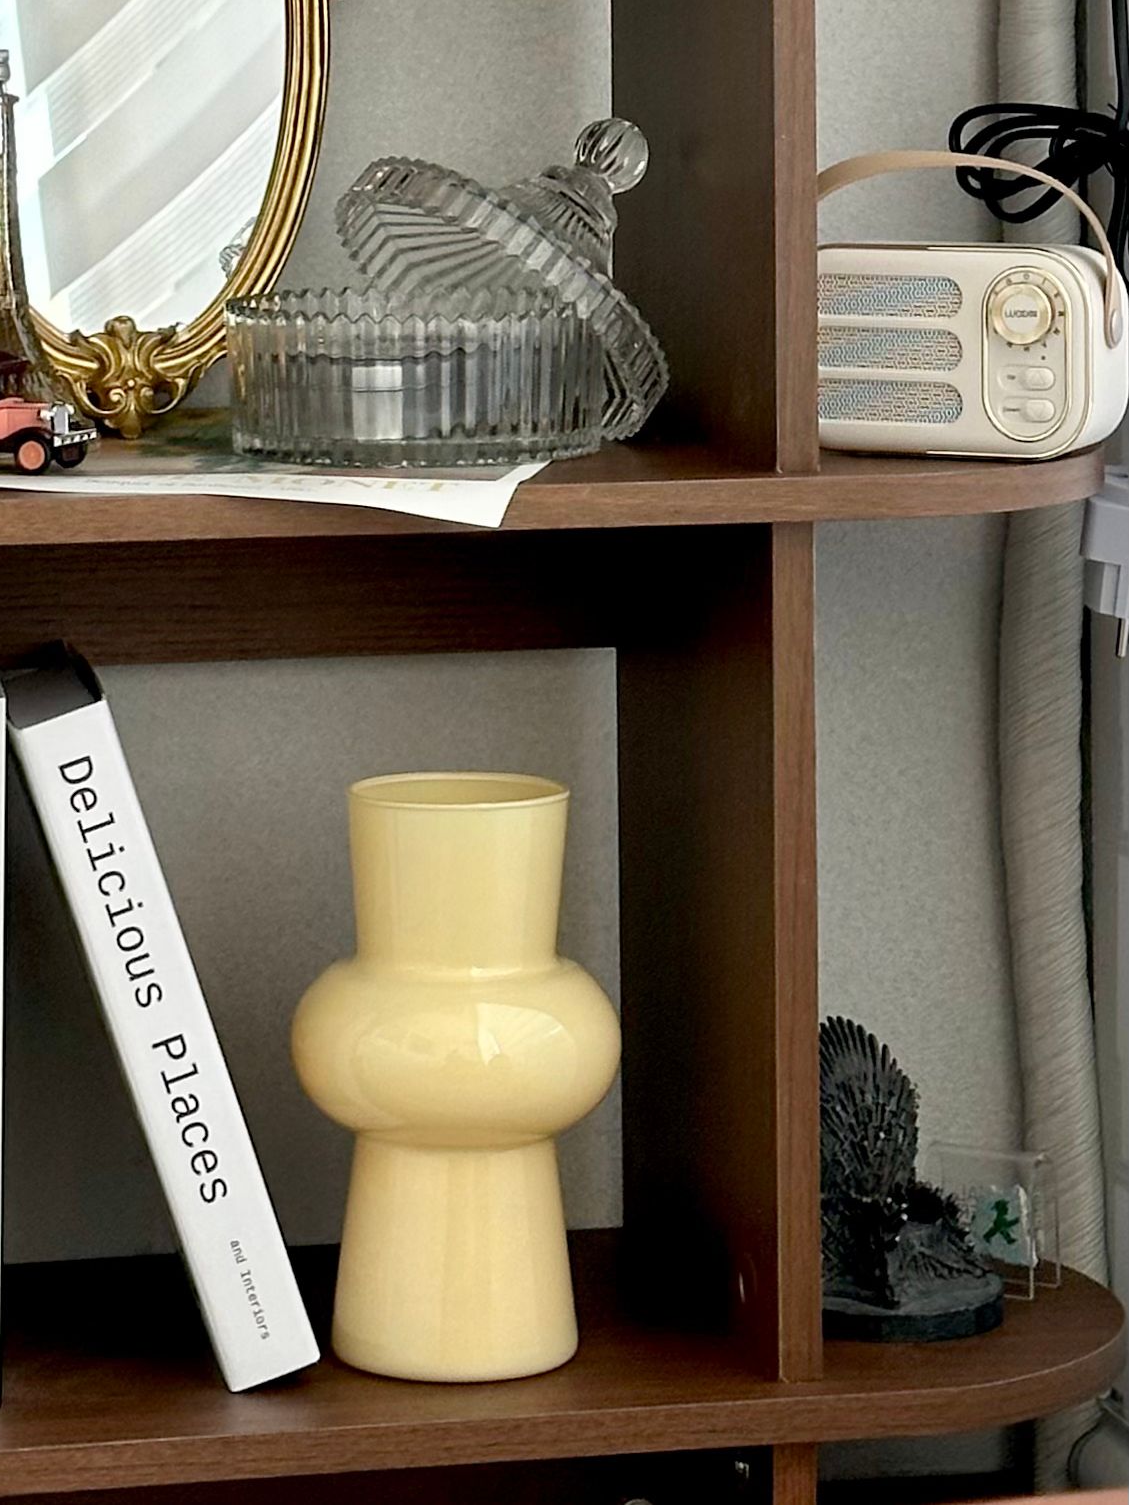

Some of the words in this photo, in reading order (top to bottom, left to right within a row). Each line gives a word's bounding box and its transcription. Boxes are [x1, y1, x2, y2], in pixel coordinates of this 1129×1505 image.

[58, 755, 163, 1008] Delicious
[151, 1032, 228, 1204] Places
[230, 1241, 247, 1264] and
[240, 1270, 269, 1339] Interiors
